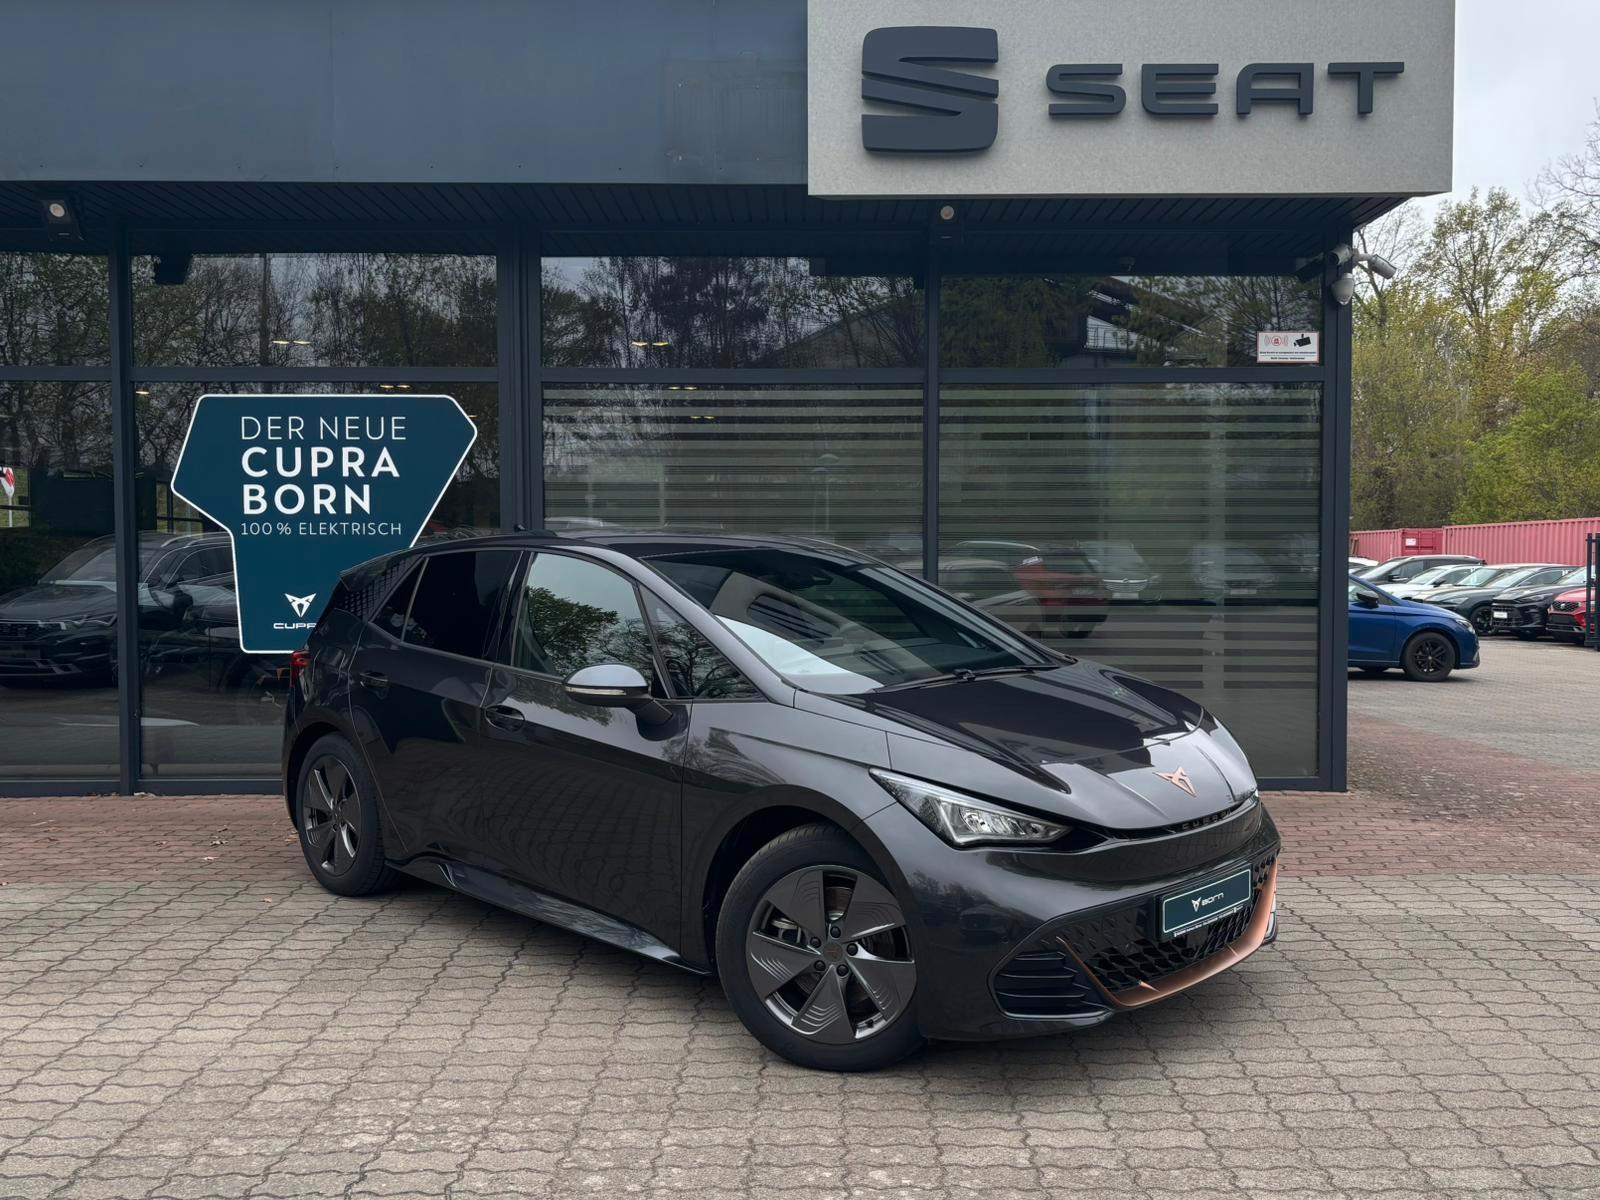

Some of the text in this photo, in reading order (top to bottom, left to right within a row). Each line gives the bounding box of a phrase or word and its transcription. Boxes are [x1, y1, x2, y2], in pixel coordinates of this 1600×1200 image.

[1046, 62, 1405, 117] SEAT
[241, 416, 407, 440] DER NEUE
[241, 446, 400, 478] CUPRA
[243, 483, 371, 515] BORN
[241, 522, 402, 536] 100 % ELEKTRISCH
